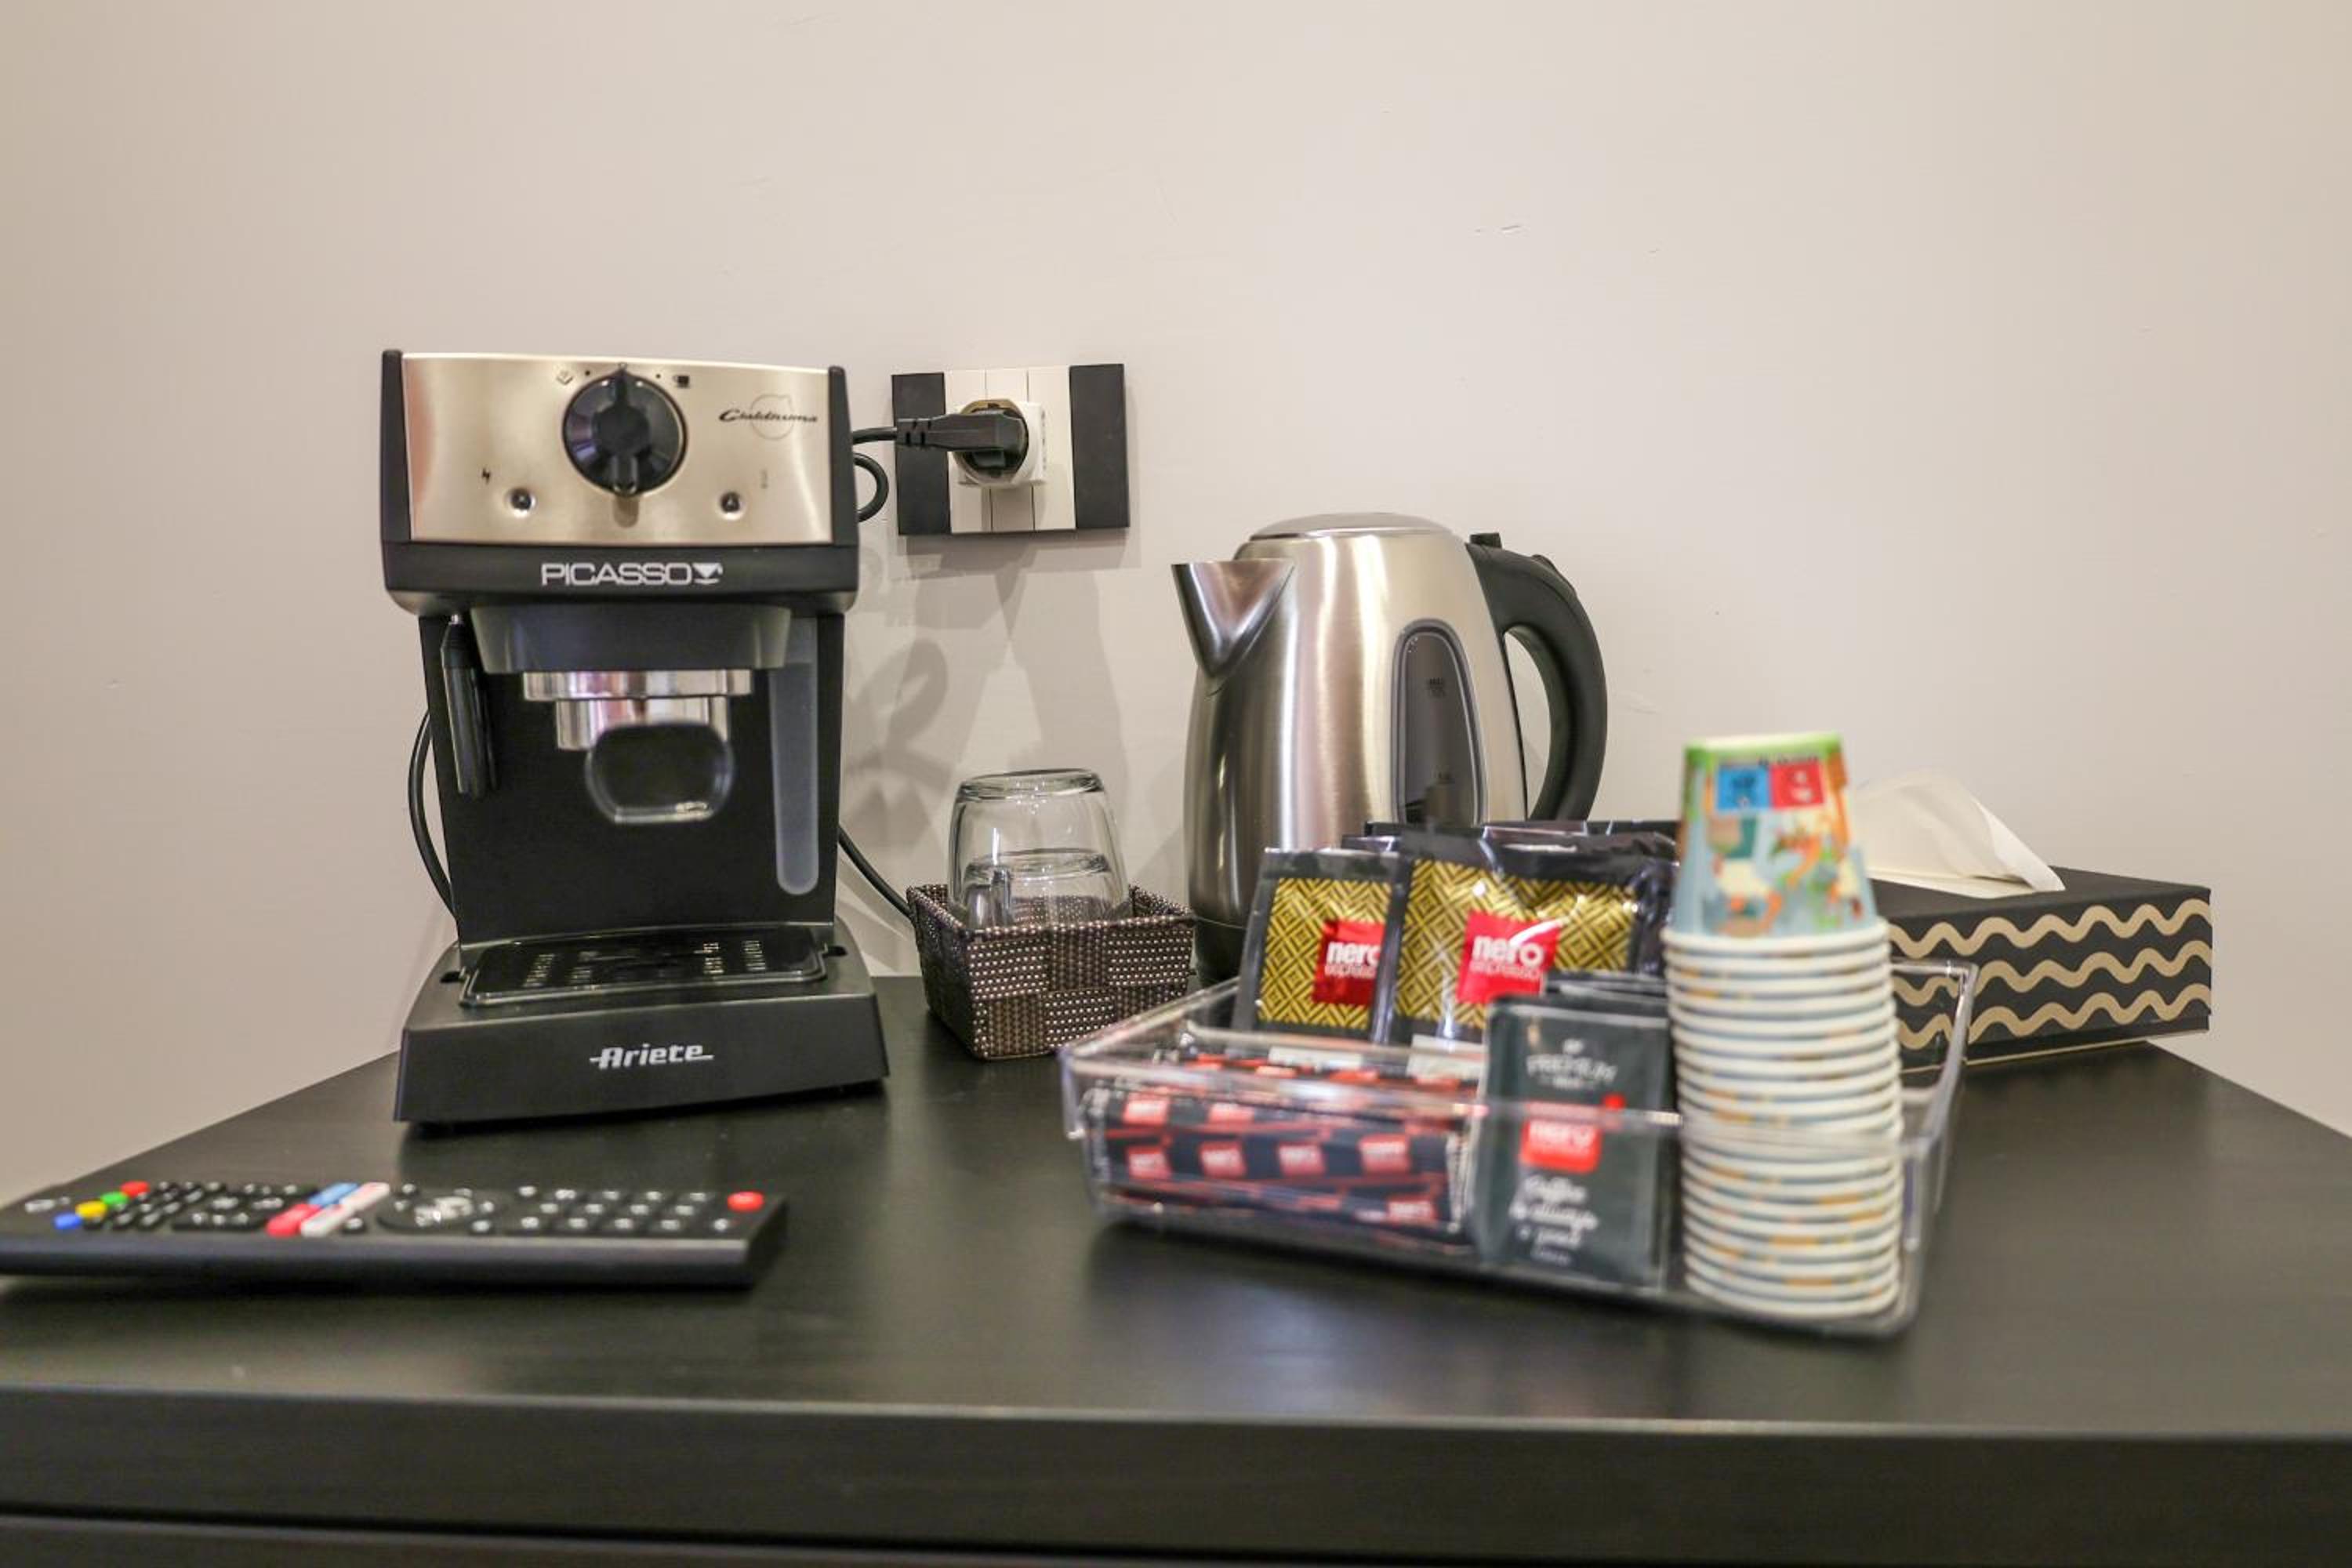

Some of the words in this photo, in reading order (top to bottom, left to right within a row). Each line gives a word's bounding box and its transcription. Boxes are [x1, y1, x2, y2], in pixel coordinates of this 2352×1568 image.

[541, 562, 692, 586] PICASSO
[1472, 935, 1544, 968] nero
[590, 1043, 714, 1069] Ariete
